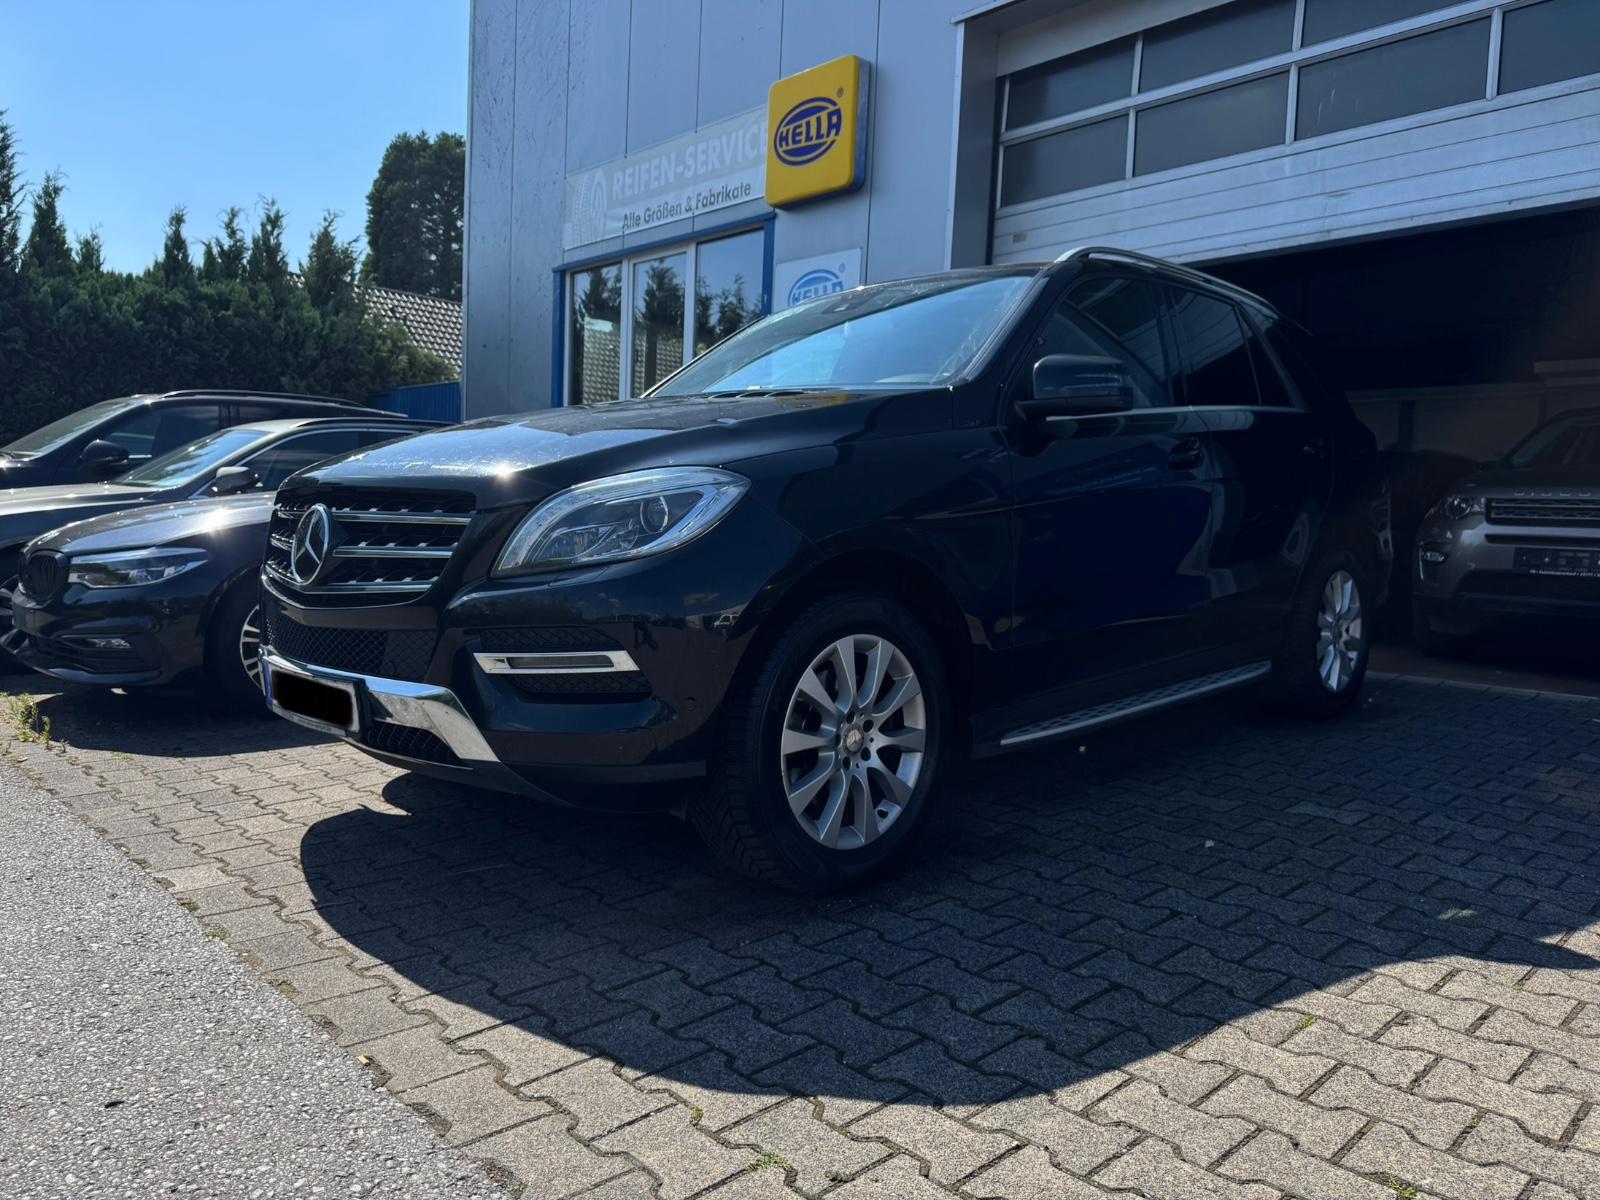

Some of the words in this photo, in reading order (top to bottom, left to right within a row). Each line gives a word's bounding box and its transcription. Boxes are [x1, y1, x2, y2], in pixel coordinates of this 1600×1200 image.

[778, 107, 843, 148] HELLA
[623, 212, 641, 229] Alle
[643, 201, 682, 224] Größen
[685, 196, 693, 212] &
[695, 181, 751, 210] Fabrikate
